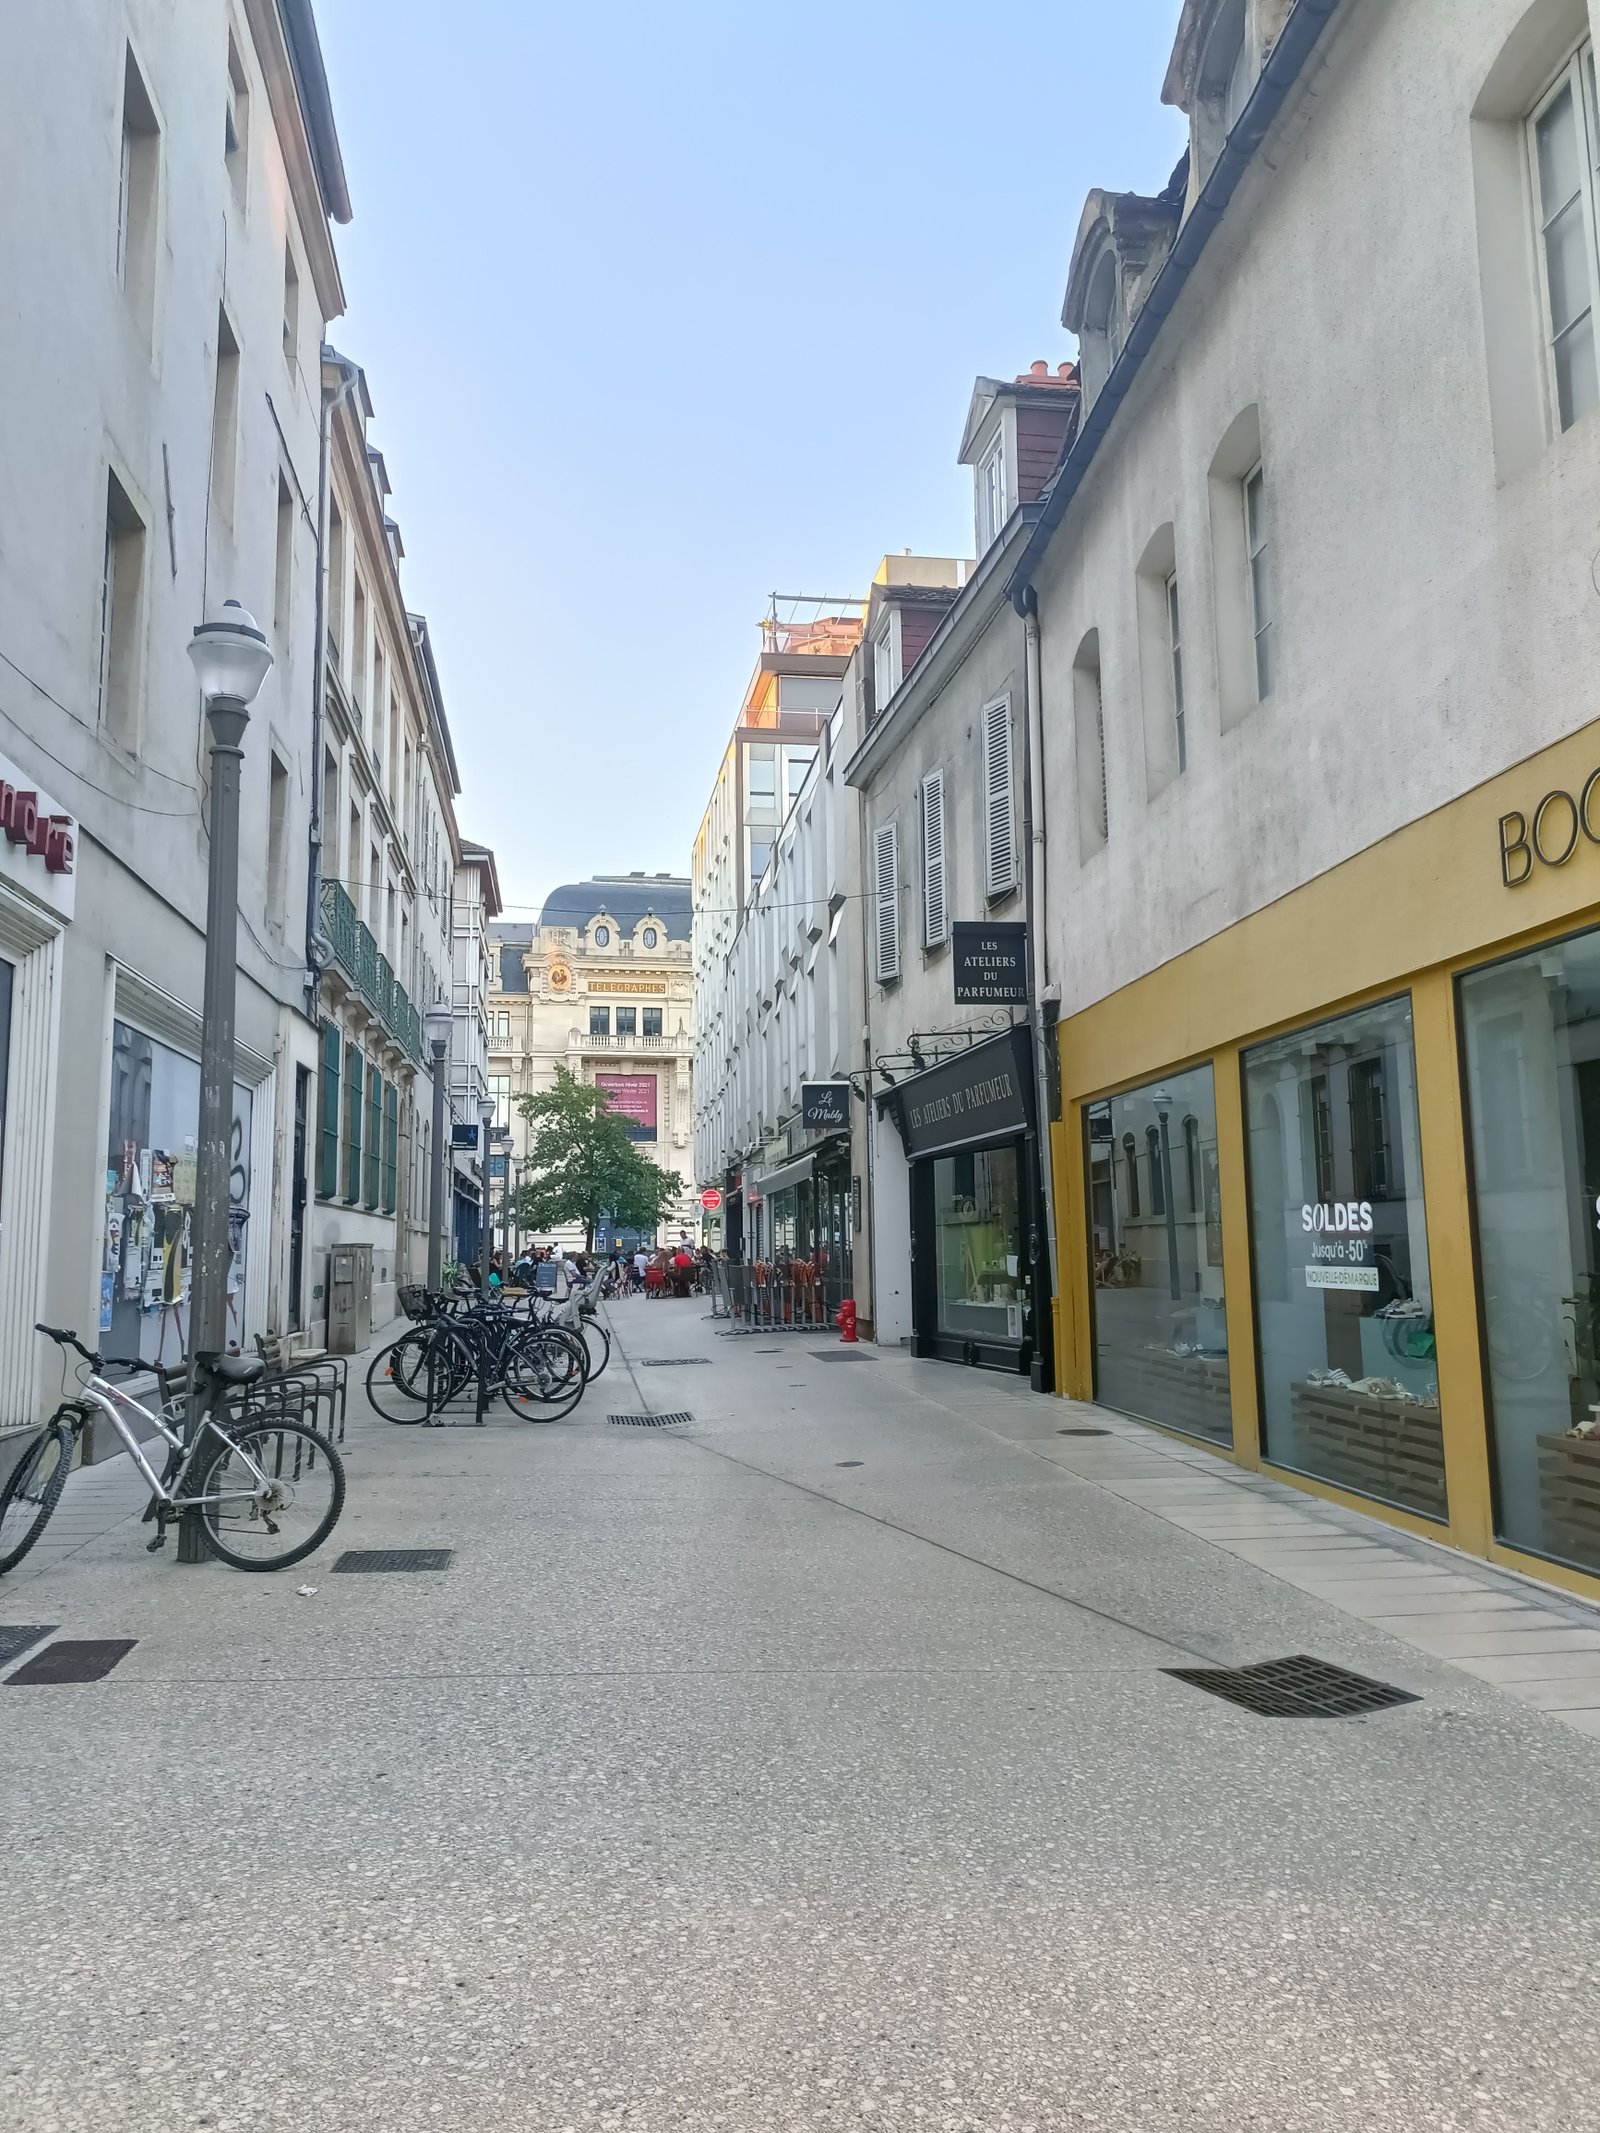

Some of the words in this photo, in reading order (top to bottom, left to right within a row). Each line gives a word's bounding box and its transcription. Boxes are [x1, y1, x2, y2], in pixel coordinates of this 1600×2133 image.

[981, 941, 998, 951] LES
[964, 956, 1016, 967] ATELIERS
[983, 971, 998, 981] DU
[957, 986, 1025, 998] PARFUMEUR
[818, 1090, 834, 1107] Le
[909, 1107, 922, 1129] LES
[922, 1096, 951, 1125] ATELIERS
[951, 1091, 964, 1114] DU
[965, 1073, 1013, 1110] PARFUMEUR
[807, 1106, 844, 1124] Mably
[1301, 1201, 1374, 1232] SOLDES
[1311, 1241, 1344, 1261] Jusqu'à
